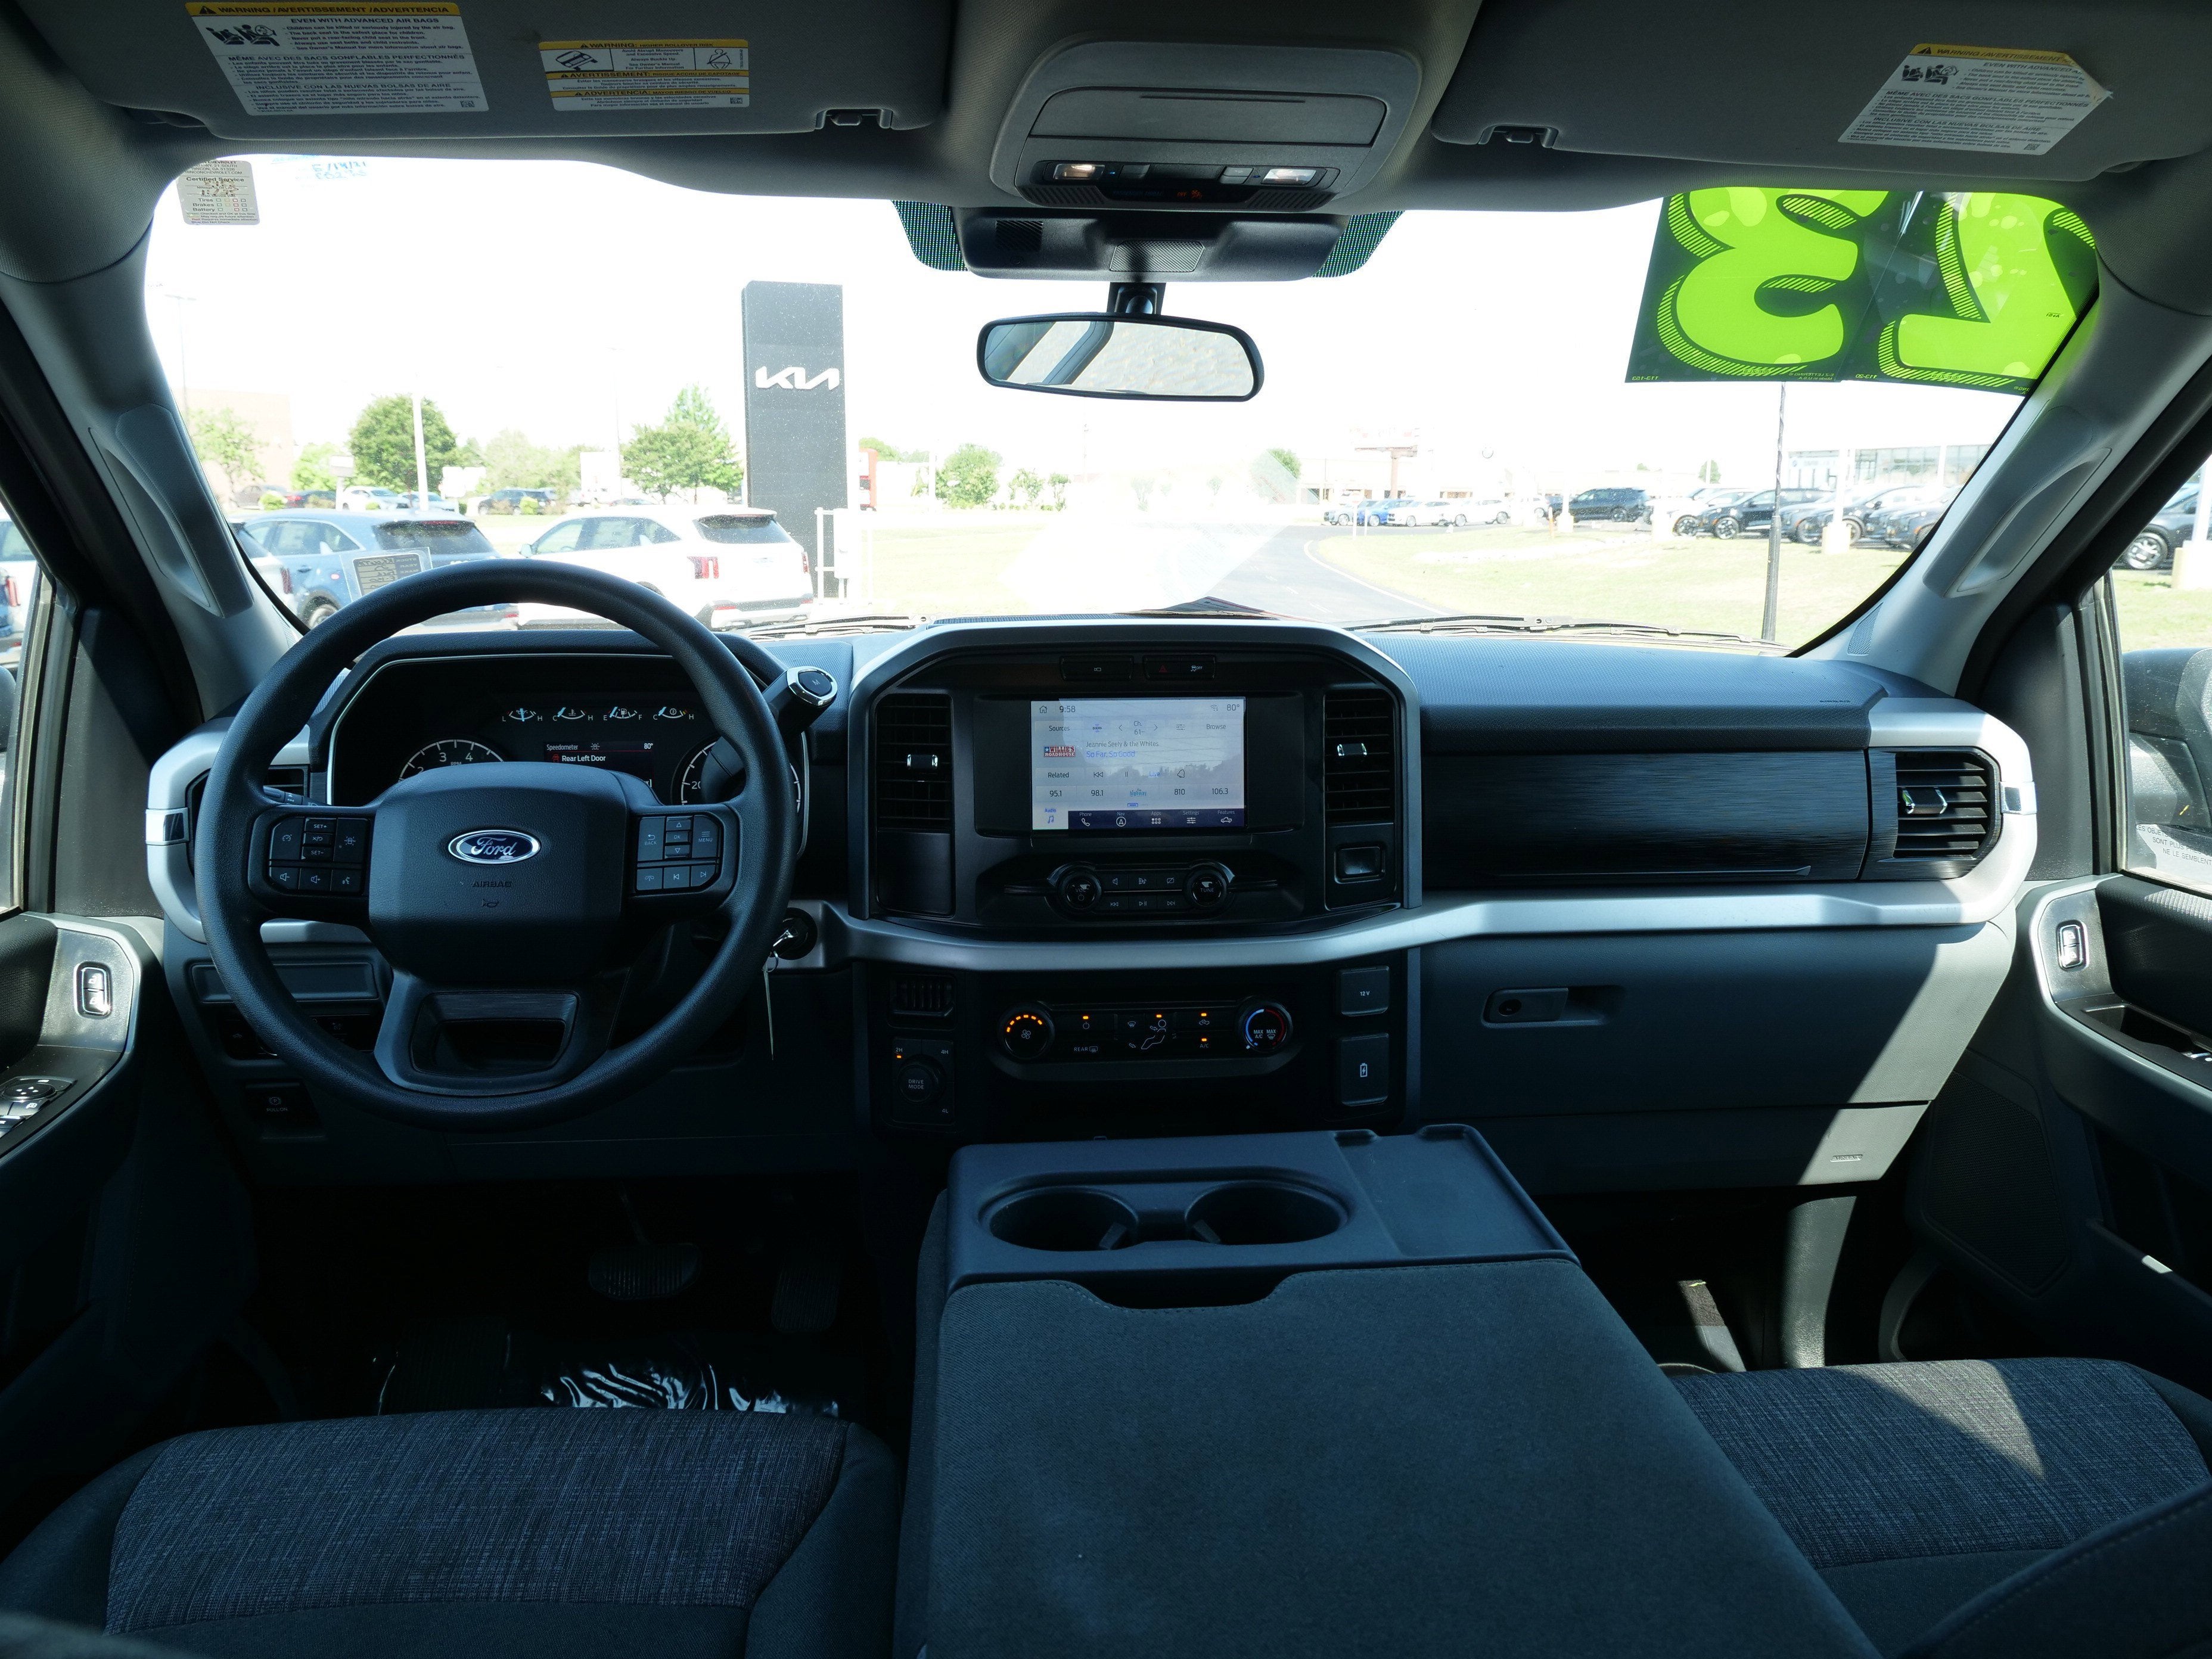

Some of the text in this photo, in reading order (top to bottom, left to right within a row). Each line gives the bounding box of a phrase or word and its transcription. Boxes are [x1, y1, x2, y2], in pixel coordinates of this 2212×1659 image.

[1937, 48, 1980, 57] WARNING
[755, 366, 840, 390] KIA
[439, 752, 447, 762] 3
[465, 752, 474, 762] 4
[471, 837, 517, 856] Ford
[2152, 837, 2168, 845] SONT
[2169, 841, 2184, 850] PLUS
[2182, 852, 2212, 866] SEMBLENT
